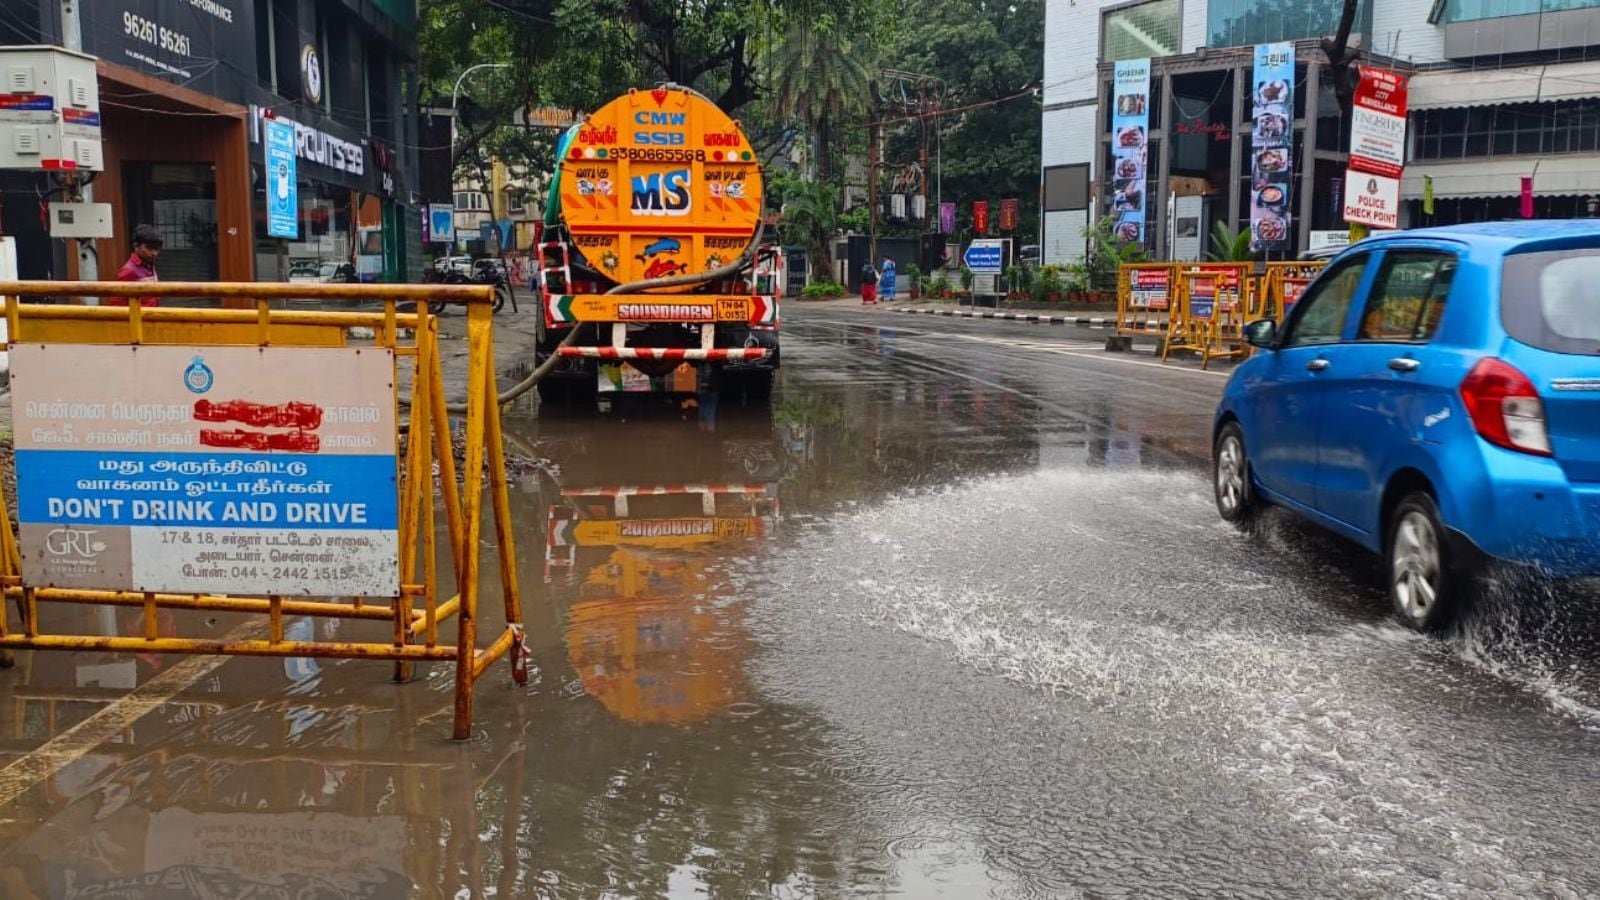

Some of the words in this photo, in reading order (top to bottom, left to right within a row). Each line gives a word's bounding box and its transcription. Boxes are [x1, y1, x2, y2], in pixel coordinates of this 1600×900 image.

[123, 11, 157, 45] 96261
[160, 27, 190, 57] 96261
[635, 111, 686, 125] CMW
[634, 131, 685, 145] SSB
[609, 148, 705, 162] 9380665568
[631, 169, 692, 217] MS
[1358, 196, 1385, 208] POLICE
[1346, 206, 1372, 218] CHECK
[1373, 211, 1397, 223] POINT
[618, 304, 713, 319] SOUNDHORN
[26, 400, 105, 419] சென்னை
[324, 403, 380, 424] காவல்
[323, 432, 377, 448] காவல்
[99, 460, 144, 474] மது
[150, 459, 308, 476] அருந்திவிட்டு
[77, 478, 180, 493] வாகனம்
[185, 479, 332, 497] ஓட்டாதீர்கள்
[48, 498, 123, 519] DON'T
[132, 499, 212, 521] DRINK
[222, 501, 277, 522] AND
[287, 503, 367, 524] DRIVE
[47, 529, 99, 558] GRT
[162, 531, 177, 543] 17
[182, 531, 192, 543] &
[197, 532, 218, 546] 18,
[232, 566, 258, 578] 044
[273, 567, 308, 579] 2442
